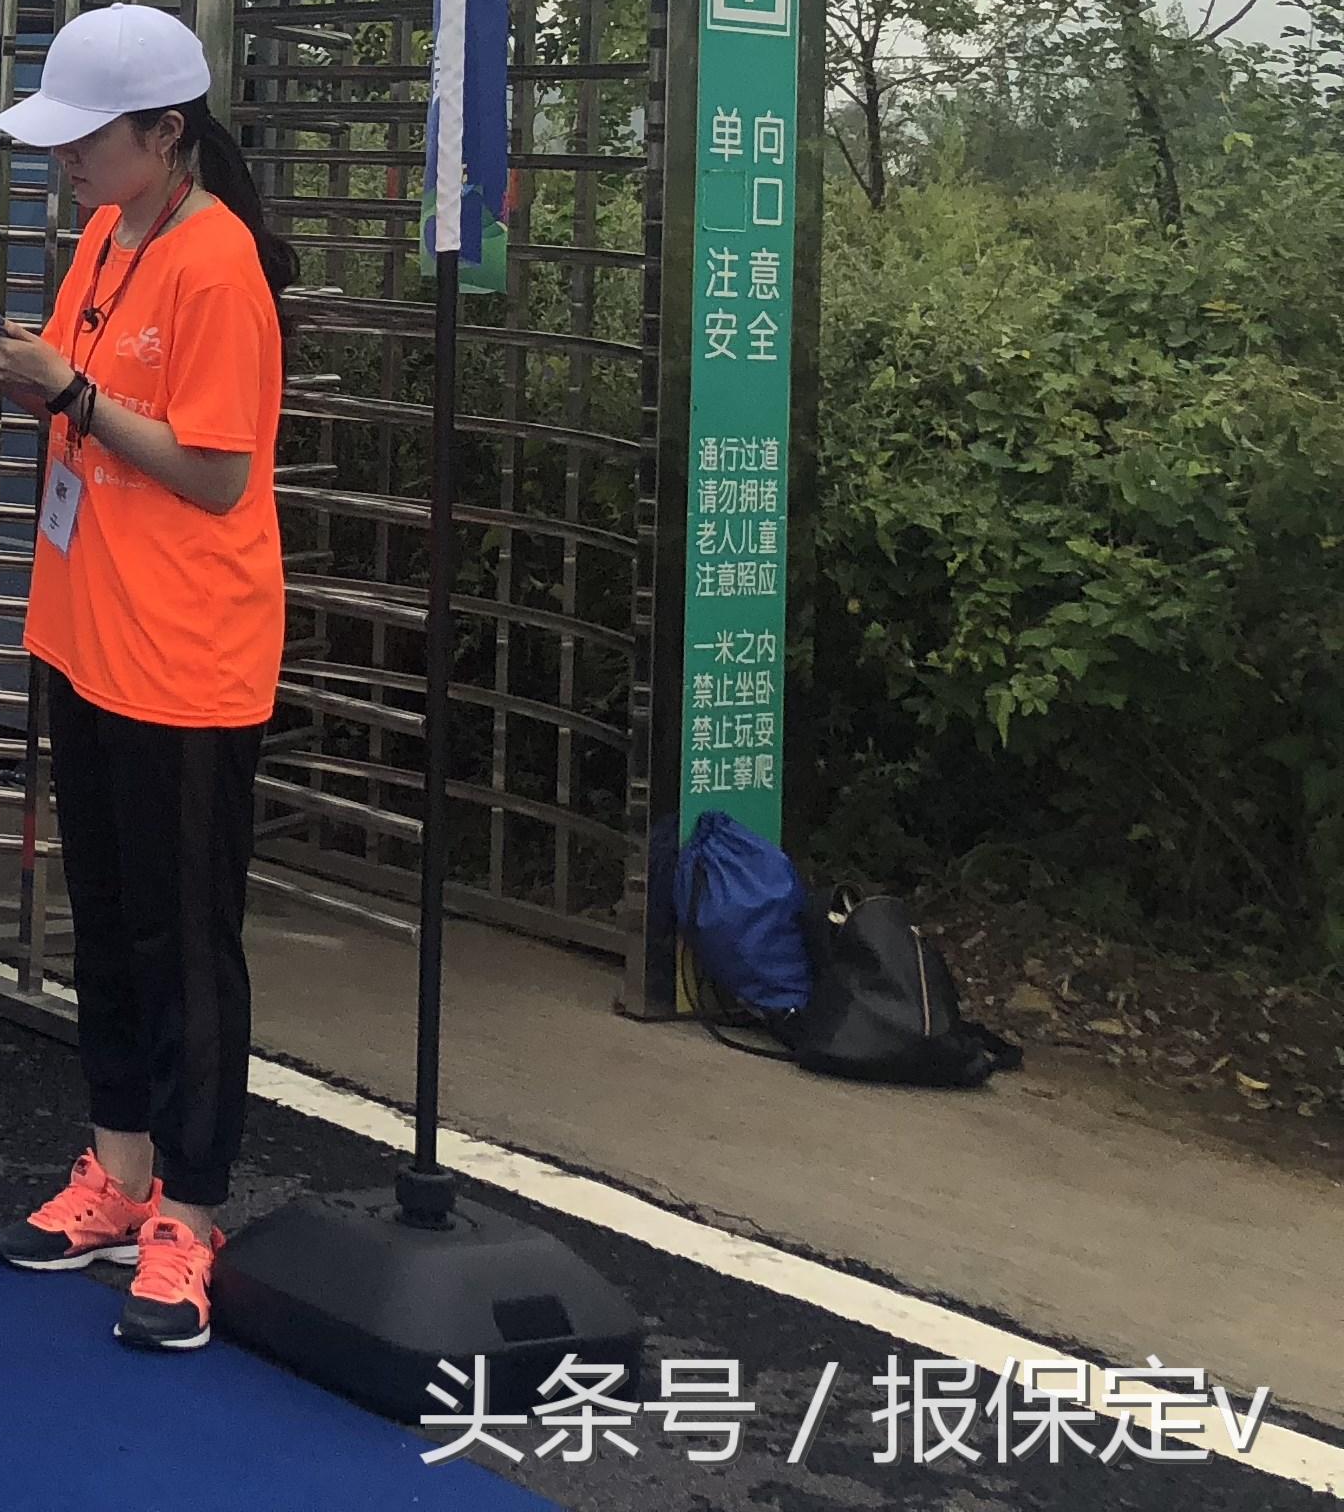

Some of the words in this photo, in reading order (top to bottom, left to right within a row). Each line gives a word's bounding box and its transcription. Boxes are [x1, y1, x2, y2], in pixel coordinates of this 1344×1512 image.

[709, 106, 785, 165] 单向
[705, 246, 780, 302] 注意
[703, 307, 780, 363] 安全
[698, 436, 780, 473] 通行过道
[697, 478, 778, 515] 请勿拥堵
[695, 519, 778, 556] 老人儿童
[695, 561, 777, 598] 注意照应
[693, 629, 776, 665] 一米之内
[692, 670, 775, 709] 禁止坐卧
[691, 713, 774, 752] 禁止玩耍
[689, 754, 774, 794] 禁止攀爬
